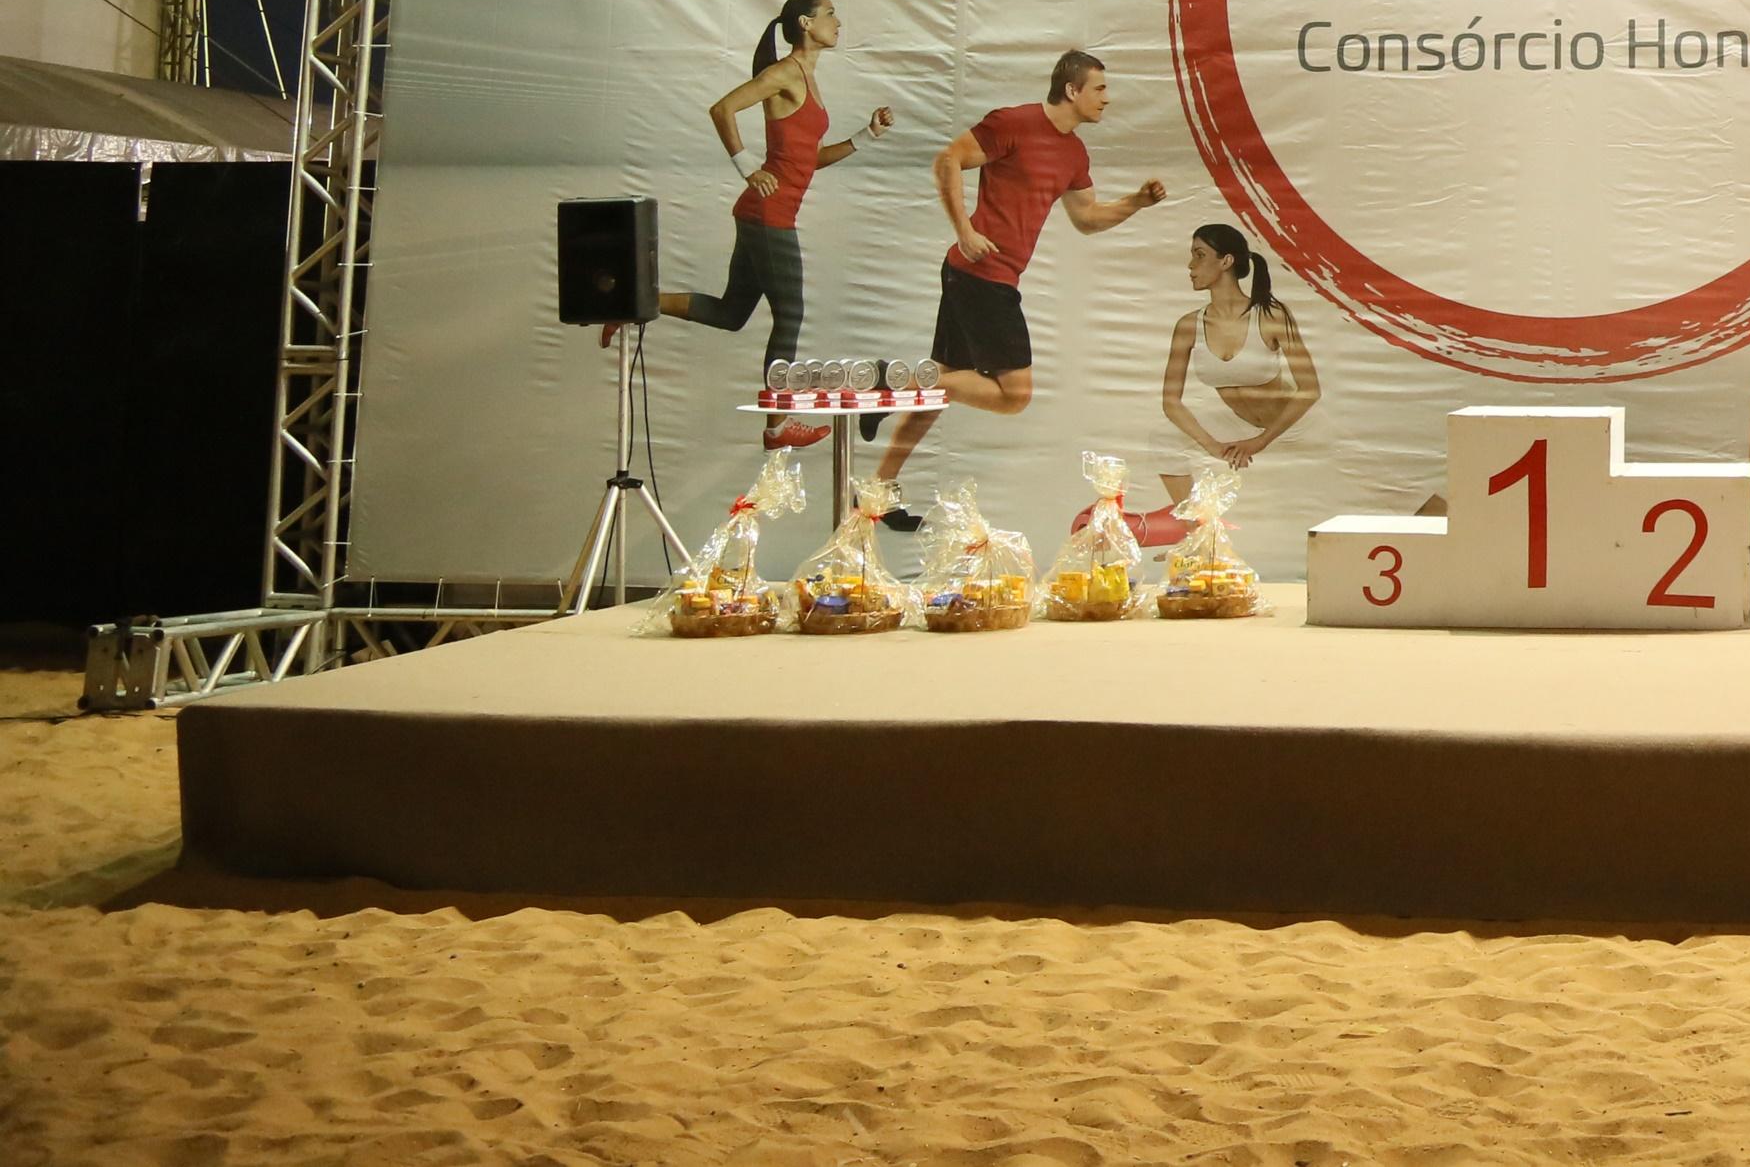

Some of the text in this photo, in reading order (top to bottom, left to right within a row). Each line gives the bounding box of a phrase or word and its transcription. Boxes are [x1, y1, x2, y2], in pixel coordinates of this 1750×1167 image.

[1299, 16, 1605, 73] Consórcio
[1487, 438, 1548, 589] 1
[1641, 498, 1717, 609] 2
[1362, 544, 1404, 607] 3
